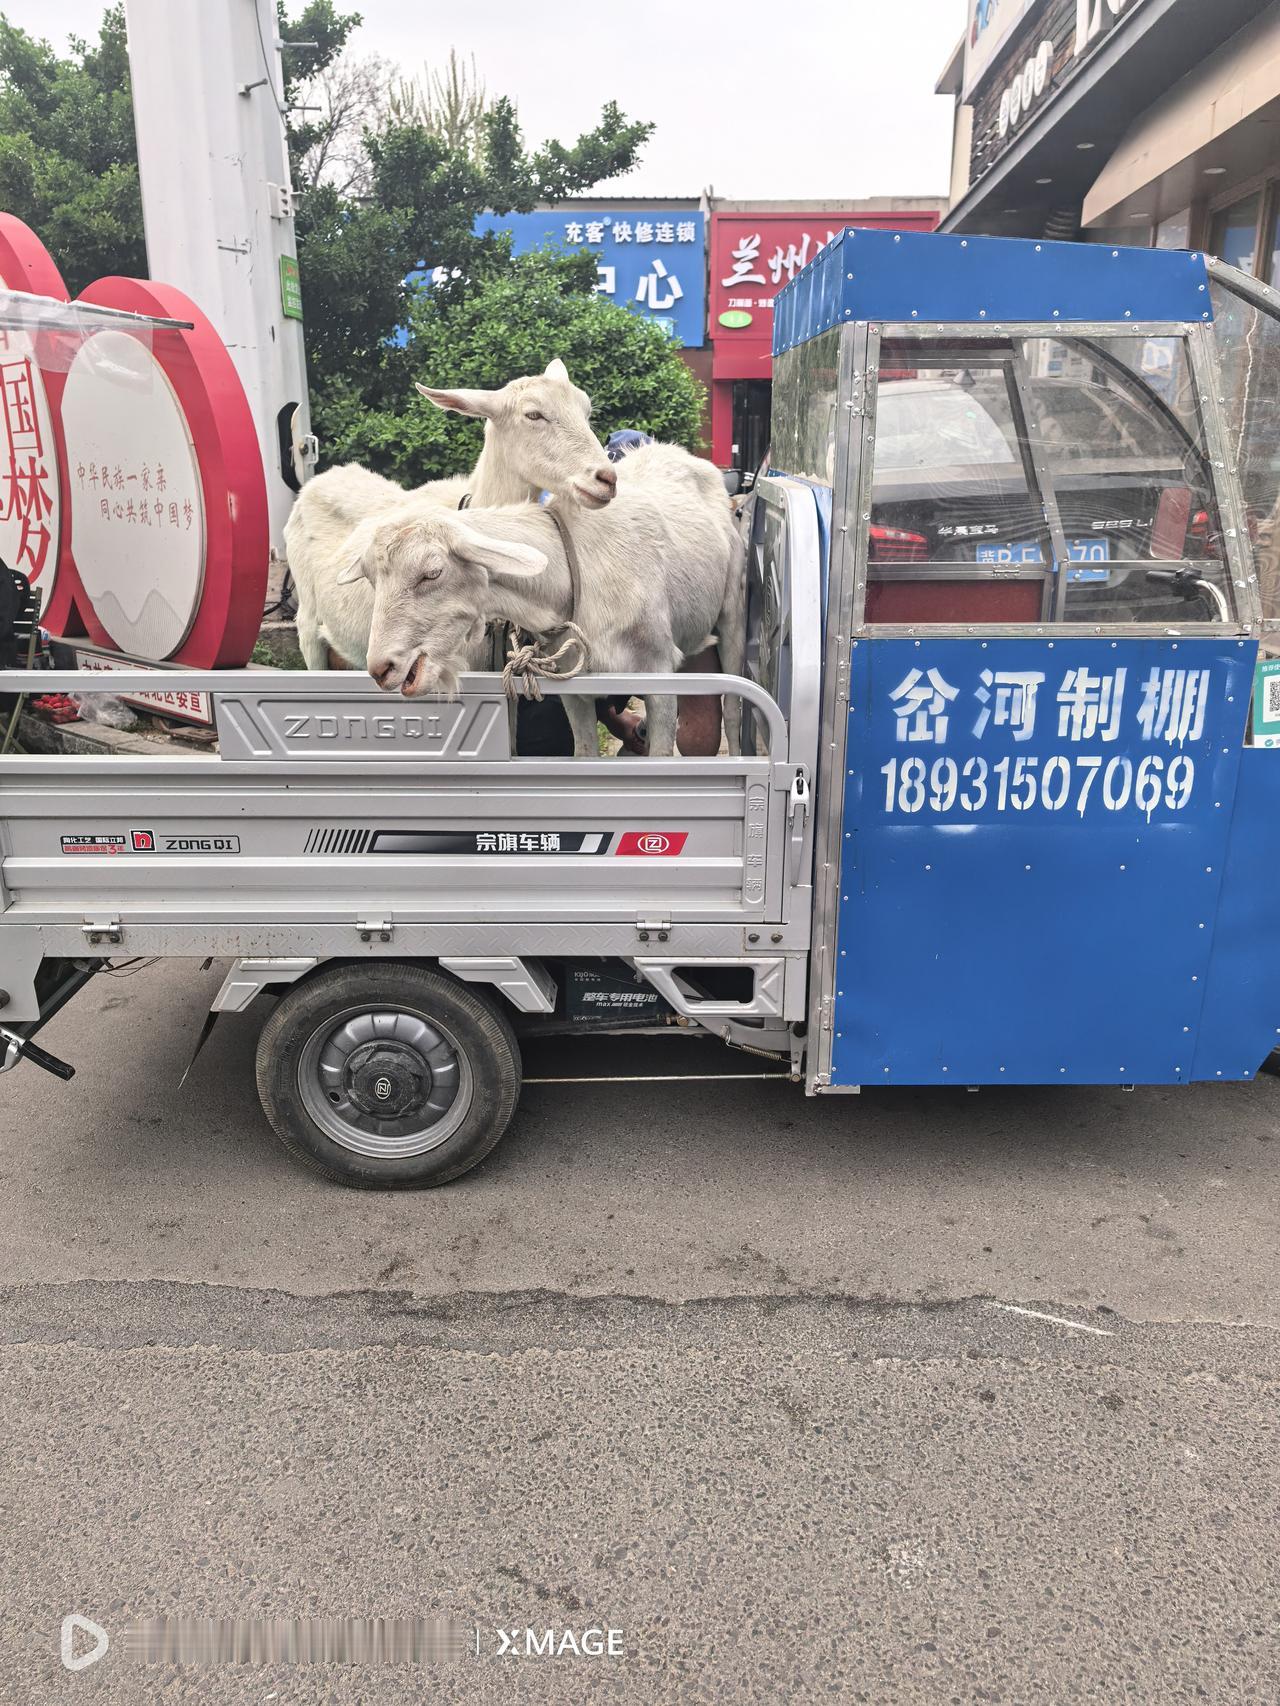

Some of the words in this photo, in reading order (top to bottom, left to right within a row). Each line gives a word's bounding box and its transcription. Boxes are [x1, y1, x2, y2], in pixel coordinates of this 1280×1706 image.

[721, 231, 835, 287] 兰州
[0, 331, 53, 584] 国梦
[77, 462, 167, 492] 中华民族一家亲
[100, 497, 193, 530] 同心共筑中国梦
[284, 715, 442, 739] ZONGQI
[888, 667, 1211, 746] 岔河制棚
[880, 755, 1195, 816] 18931507069
[476, 833, 560, 852] 宗旗车辆
